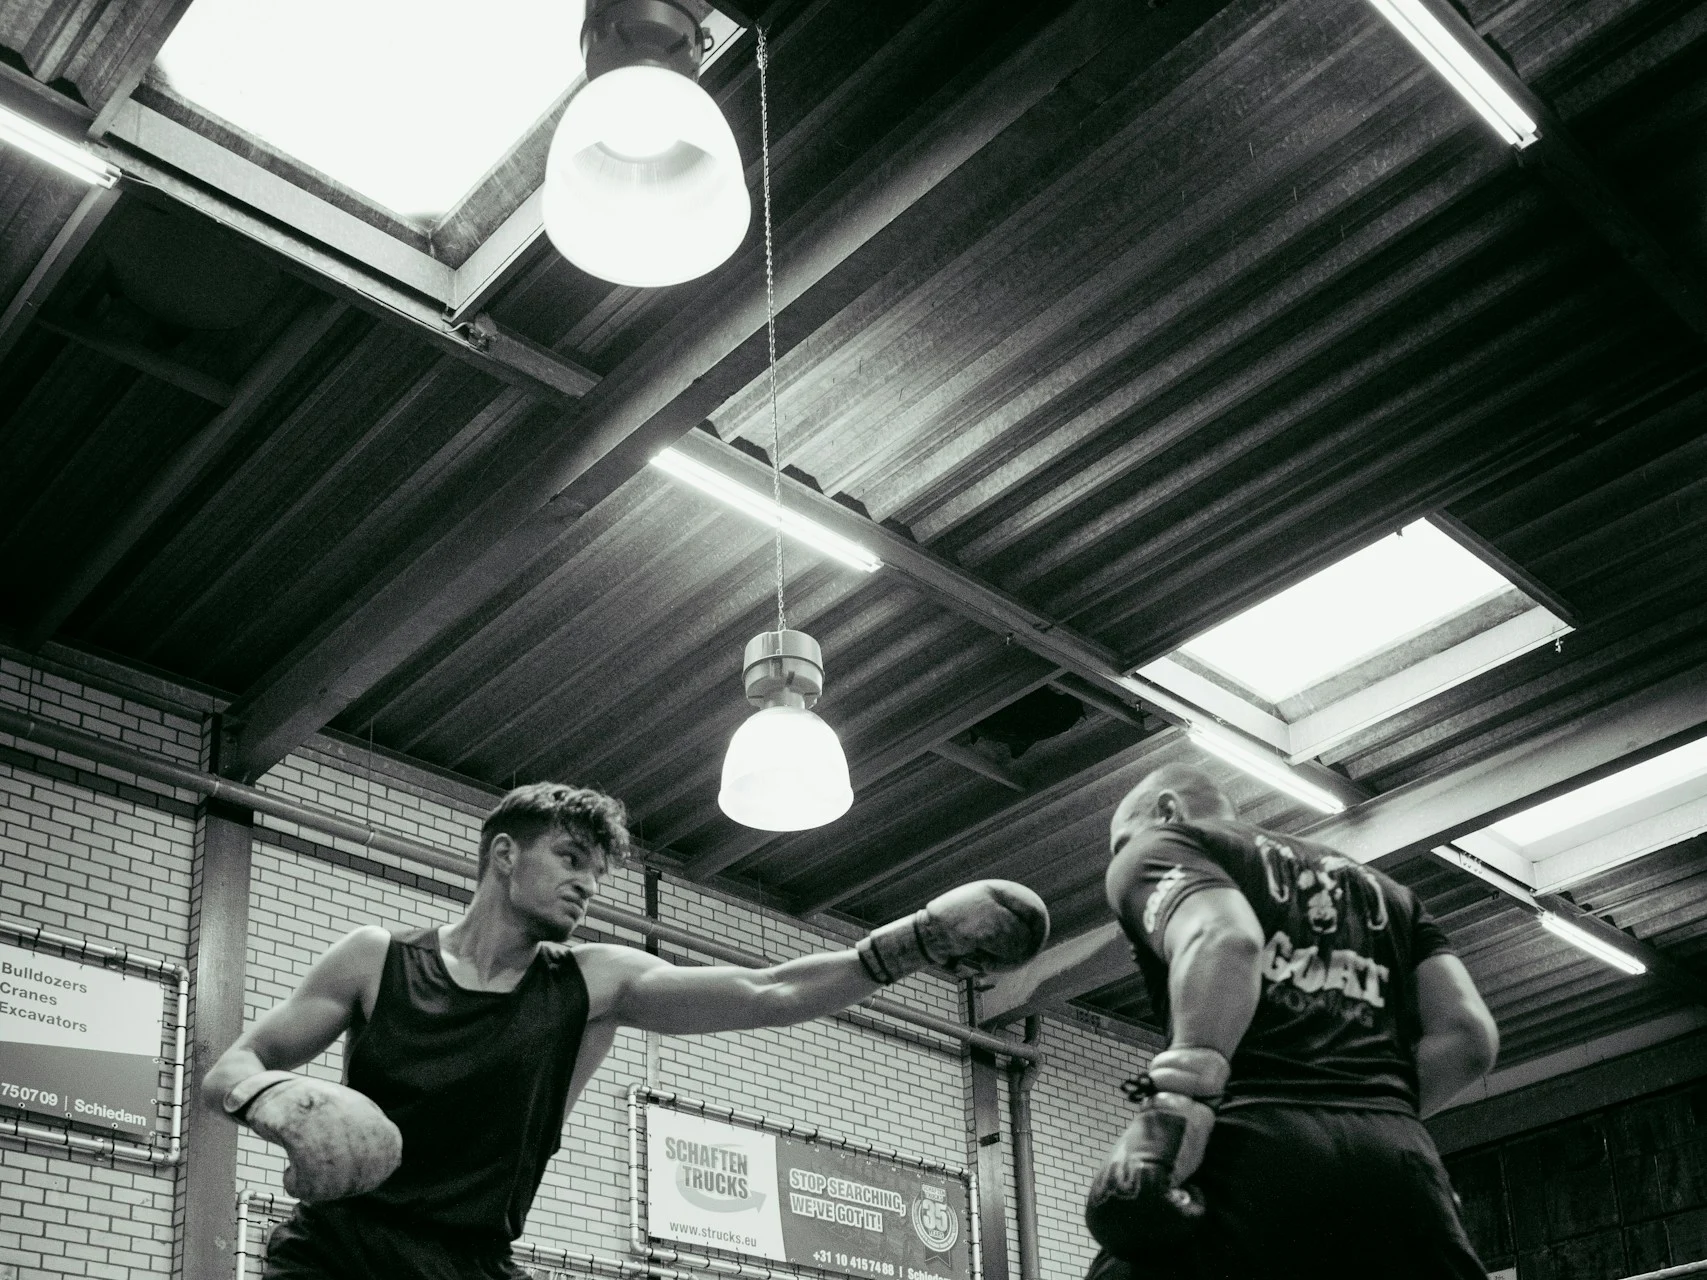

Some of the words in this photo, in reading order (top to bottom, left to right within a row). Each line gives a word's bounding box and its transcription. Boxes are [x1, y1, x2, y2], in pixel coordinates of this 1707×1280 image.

[0, 981, 58, 1006] Cranes
[2, 962, 88, 994] Bulldozers
[0, 1001, 88, 1033] Excavators
[74, 1098, 147, 1126] Schiedam
[665, 1136, 748, 1177] SCHAFTEN
[682, 1165, 749, 1200] TRUCKS
[790, 1168, 827, 1194] STOP
[828, 1177, 906, 1217] SEARCHING,
[790, 1192, 835, 1222] WE'VE
[836, 1204, 863, 1228] GOT
[863, 1209, 883, 1233] IT!
[922, 1199, 948, 1232] 35
[670, 1221, 757, 1247] www.strucks.eu
[813, 1250, 831, 1264] +31
[835, 1253, 848, 1266] 10
